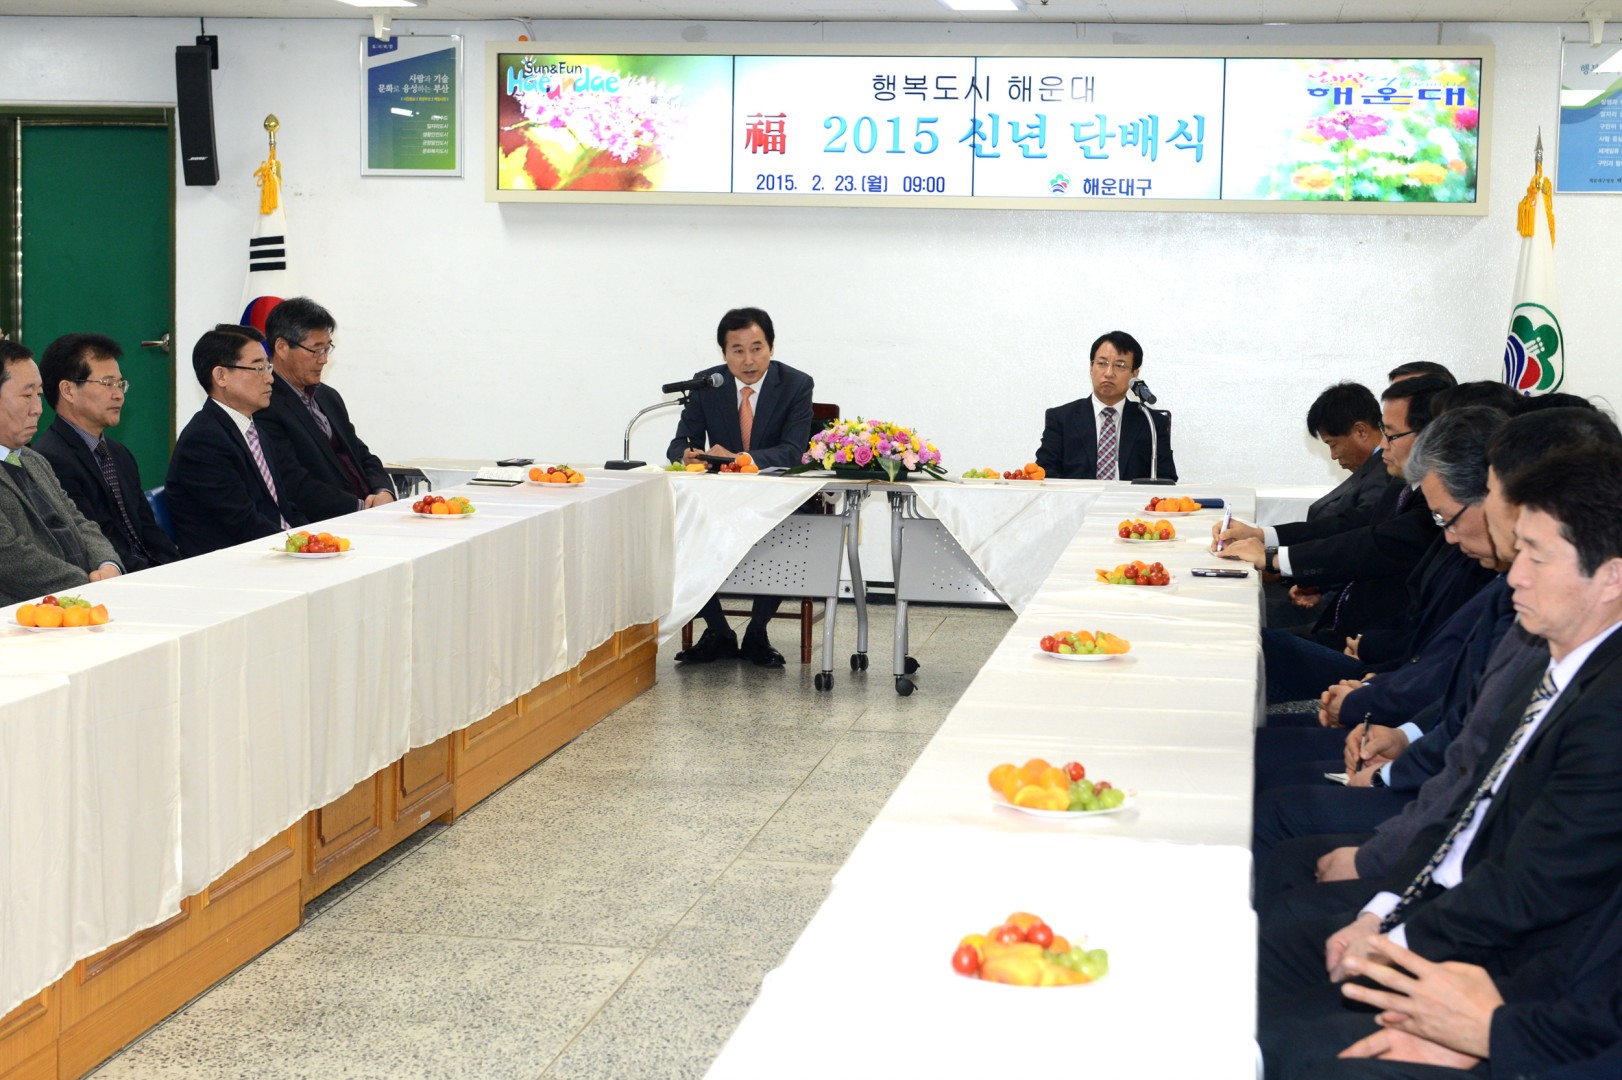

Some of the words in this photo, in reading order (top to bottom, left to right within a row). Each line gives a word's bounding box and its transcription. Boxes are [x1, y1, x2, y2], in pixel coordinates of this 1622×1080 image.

[524, 61, 582, 75] Sun&Fun
[409, 74, 431, 84] 사람과
[433, 74, 449, 84] 기술
[507, 66, 620, 100] Haeundae
[872, 75, 990, 102] 행복도시
[1008, 75, 1095, 102] 해운대
[378, 84, 400, 94] 문화로
[433, 84, 449, 94] 부산
[1307, 87, 1466, 106] 해운대
[744, 112, 787, 154] 福
[823, 116, 939, 155] 2015
[958, 112, 1048, 159] 신년
[1070, 113, 1206, 163] 단배식
[756, 174, 798, 191] 2015.
[812, 175, 825, 191] 2.
[835, 175, 888, 193] 23.(월)
[903, 176, 946, 193] 09:00
[1083, 178, 1152, 197] 해운대구
